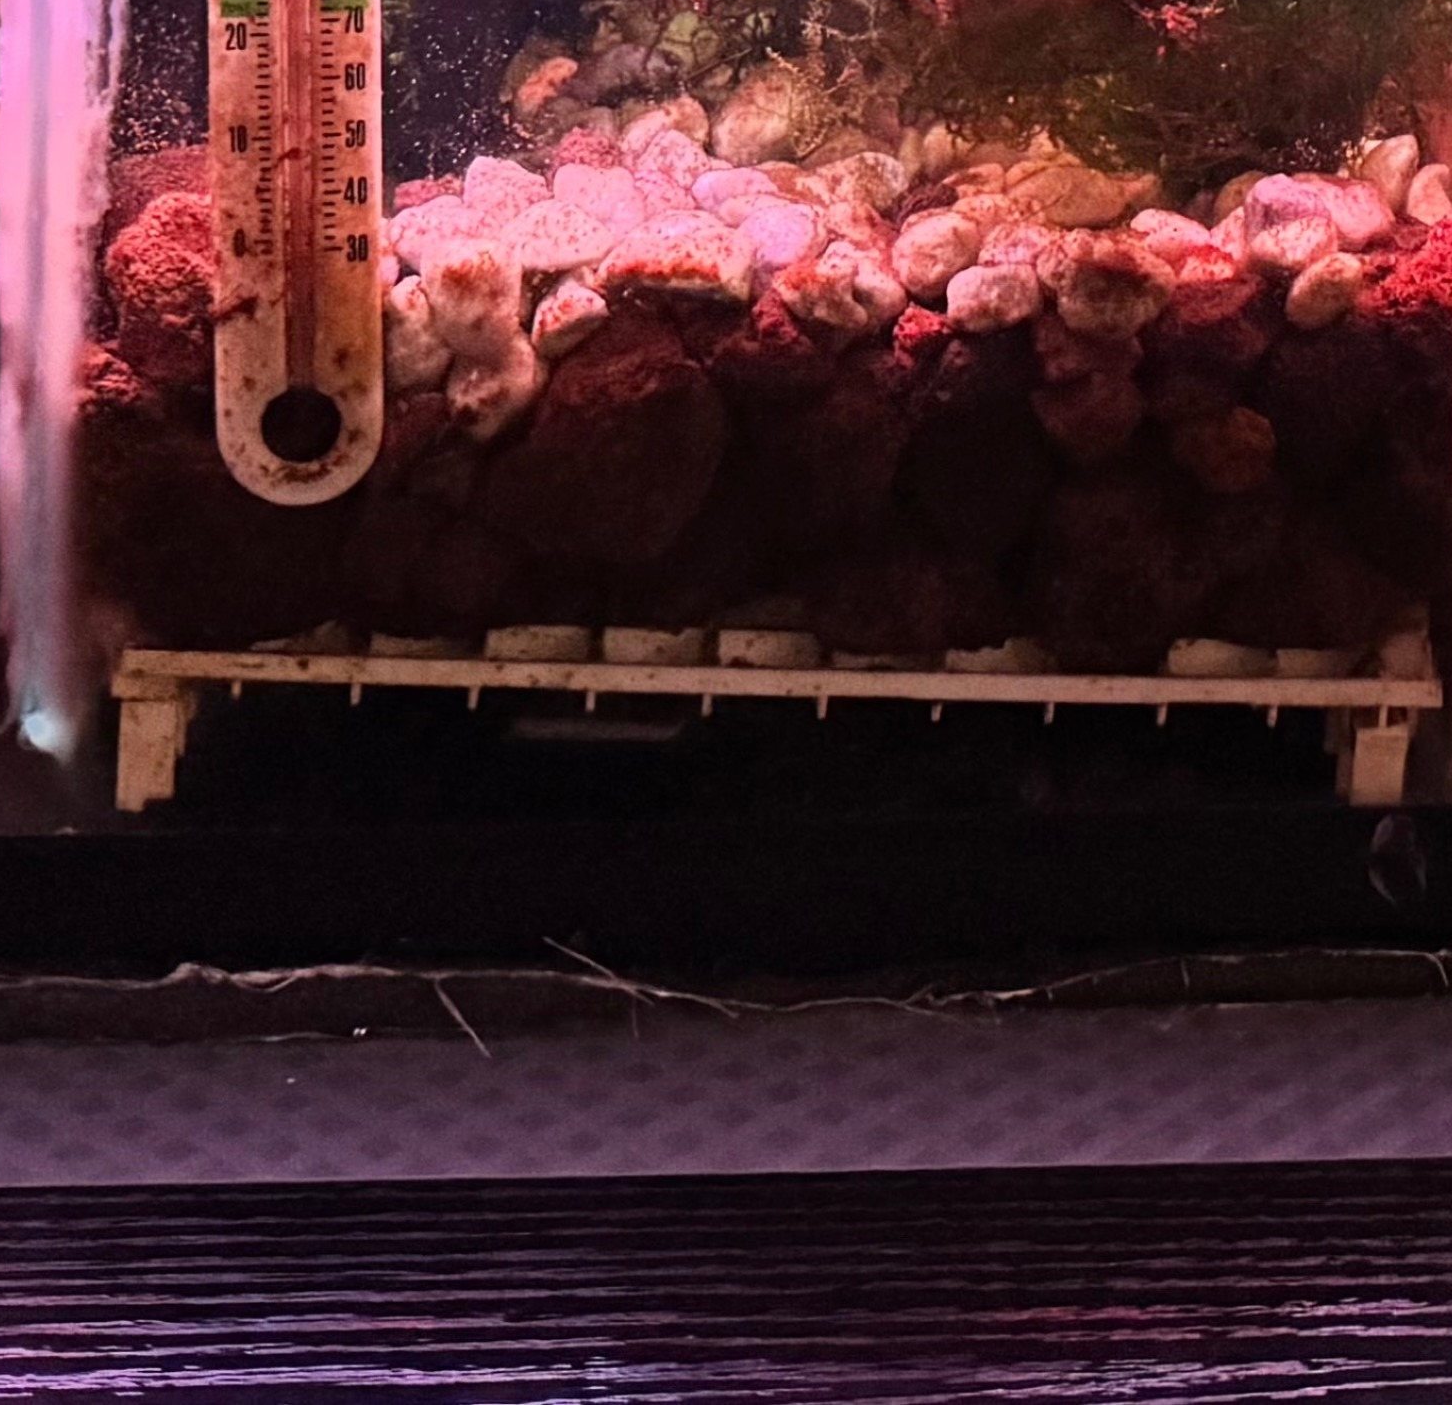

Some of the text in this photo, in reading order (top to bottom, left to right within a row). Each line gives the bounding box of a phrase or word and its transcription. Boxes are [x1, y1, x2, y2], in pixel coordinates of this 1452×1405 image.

[344, 5, 365, 34] 70
[224, 22, 248, 51] 20
[344, 61, 367, 91] 60
[228, 125, 248, 154] 10
[344, 118, 367, 148] 50
[343, 175, 368, 205] 40
[232, 227, 247, 258] 0
[345, 232, 369, 262] 30
